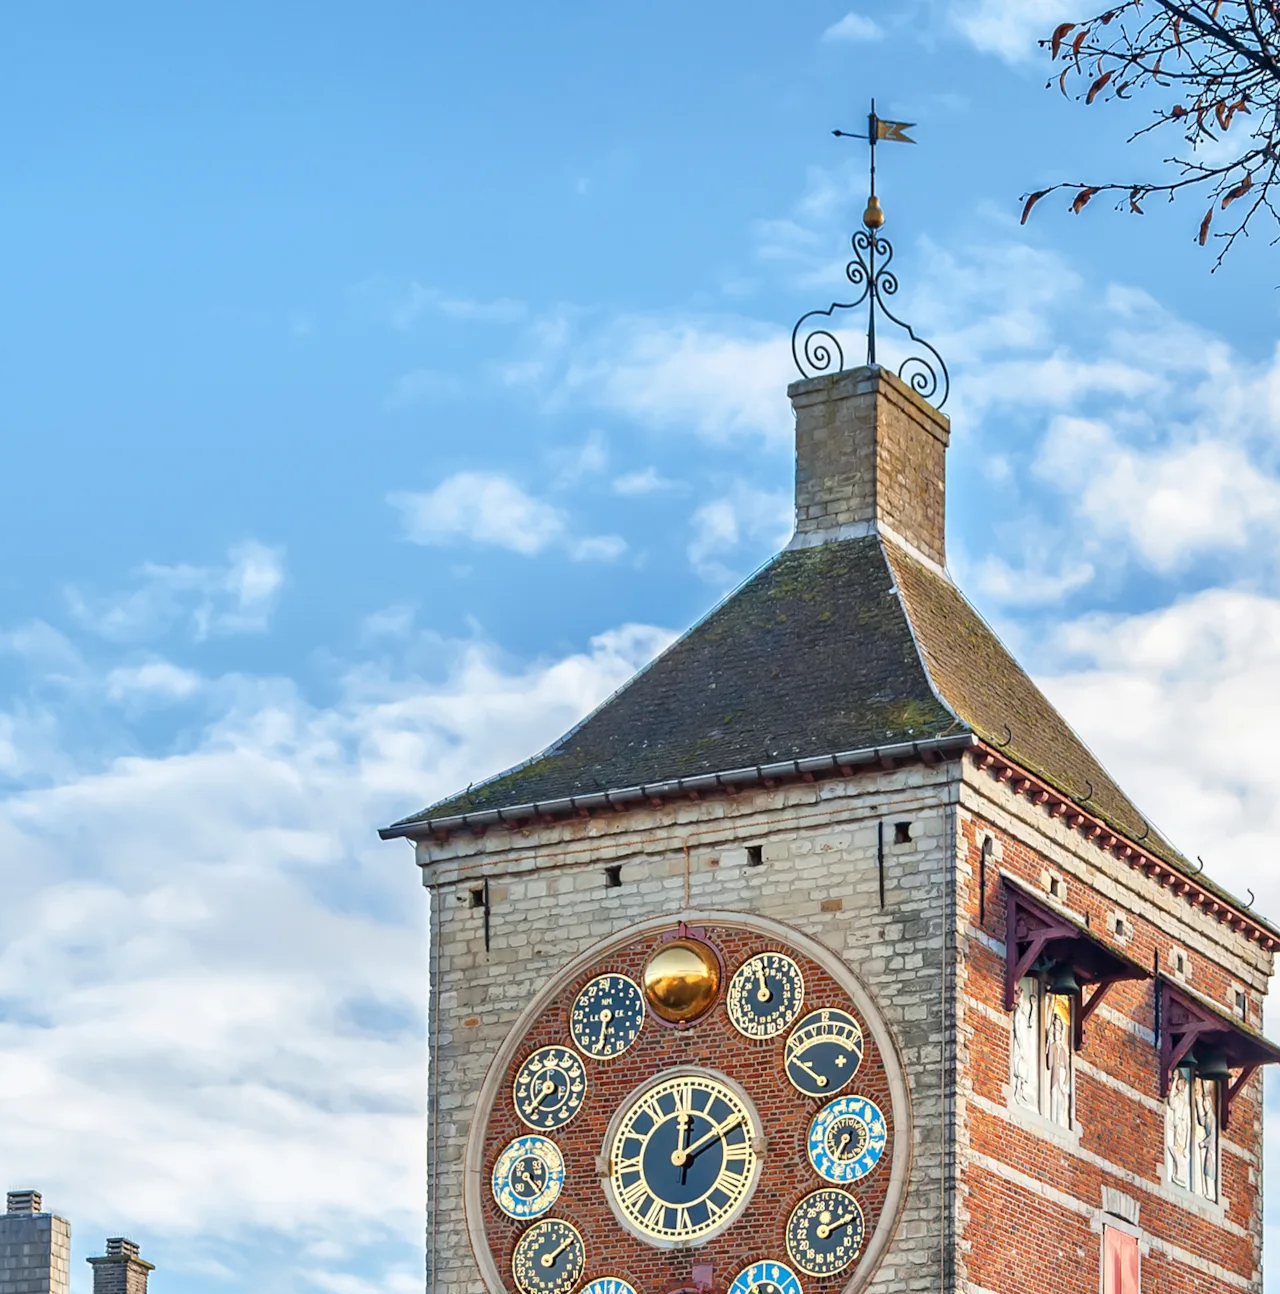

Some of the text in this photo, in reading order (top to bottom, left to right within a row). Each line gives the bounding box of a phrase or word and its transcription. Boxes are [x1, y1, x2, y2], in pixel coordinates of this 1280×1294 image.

[763, 956, 767, 966] 1
[772, 957, 779, 968] 2
[781, 961, 788, 971] 3
[744, 965, 752, 977] 18
[790, 967, 796, 977] 4
[618, 980, 623, 989] 3
[736, 978, 744, 988] 17
[794, 977, 800, 987] 5
[589, 987, 597, 996] 27
[628, 988, 634, 997] 5
[732, 988, 741, 999] 16
[794, 988, 801, 999] 6
[580, 996, 589, 1005] 25
[731, 999, 740, 1009] 15
[635, 1001, 640, 1010] 7
[793, 1000, 799, 1011] 7
[574, 1011, 583, 1019] 23
[733, 1008, 742, 1019] 14
[785, 1010, 792, 1021] 8
[636, 1016, 641, 1025] 9
[740, 1017, 748, 1027] 13
[777, 1018, 784, 1029] 9
[575, 1024, 582, 1033] 21
[748, 1023, 757, 1033] 12
[758, 1025, 764, 1035] 11
[767, 1023, 776, 1033] 10
[629, 1030, 634, 1039] 11
[581, 1036, 589, 1045] 19
[592, 1045, 599, 1054] 17
[604, 1045, 611, 1054] 15
[616, 1041, 624, 1050] 13
[516, 1162, 525, 1171] 92
[533, 1161, 541, 1169] 93
[515, 1184, 524, 1192] 90
[541, 1224, 547, 1233] 31
[559, 1225, 564, 1234] 3
[797, 1201, 852, 1263] 2 4 8 10 12 14 16 18 20 22 24 26 28
[520, 1242, 528, 1251] 27
[575, 1243, 580, 1253] 7
[516, 1255, 525, 1264] 25
[577, 1257, 582, 1265] 9
[517, 1267, 525, 1276] 23
[573, 1270, 578, 1279] 11
[521, 1279, 528, 1288] 21
[564, 1281, 571, 1290] 13
